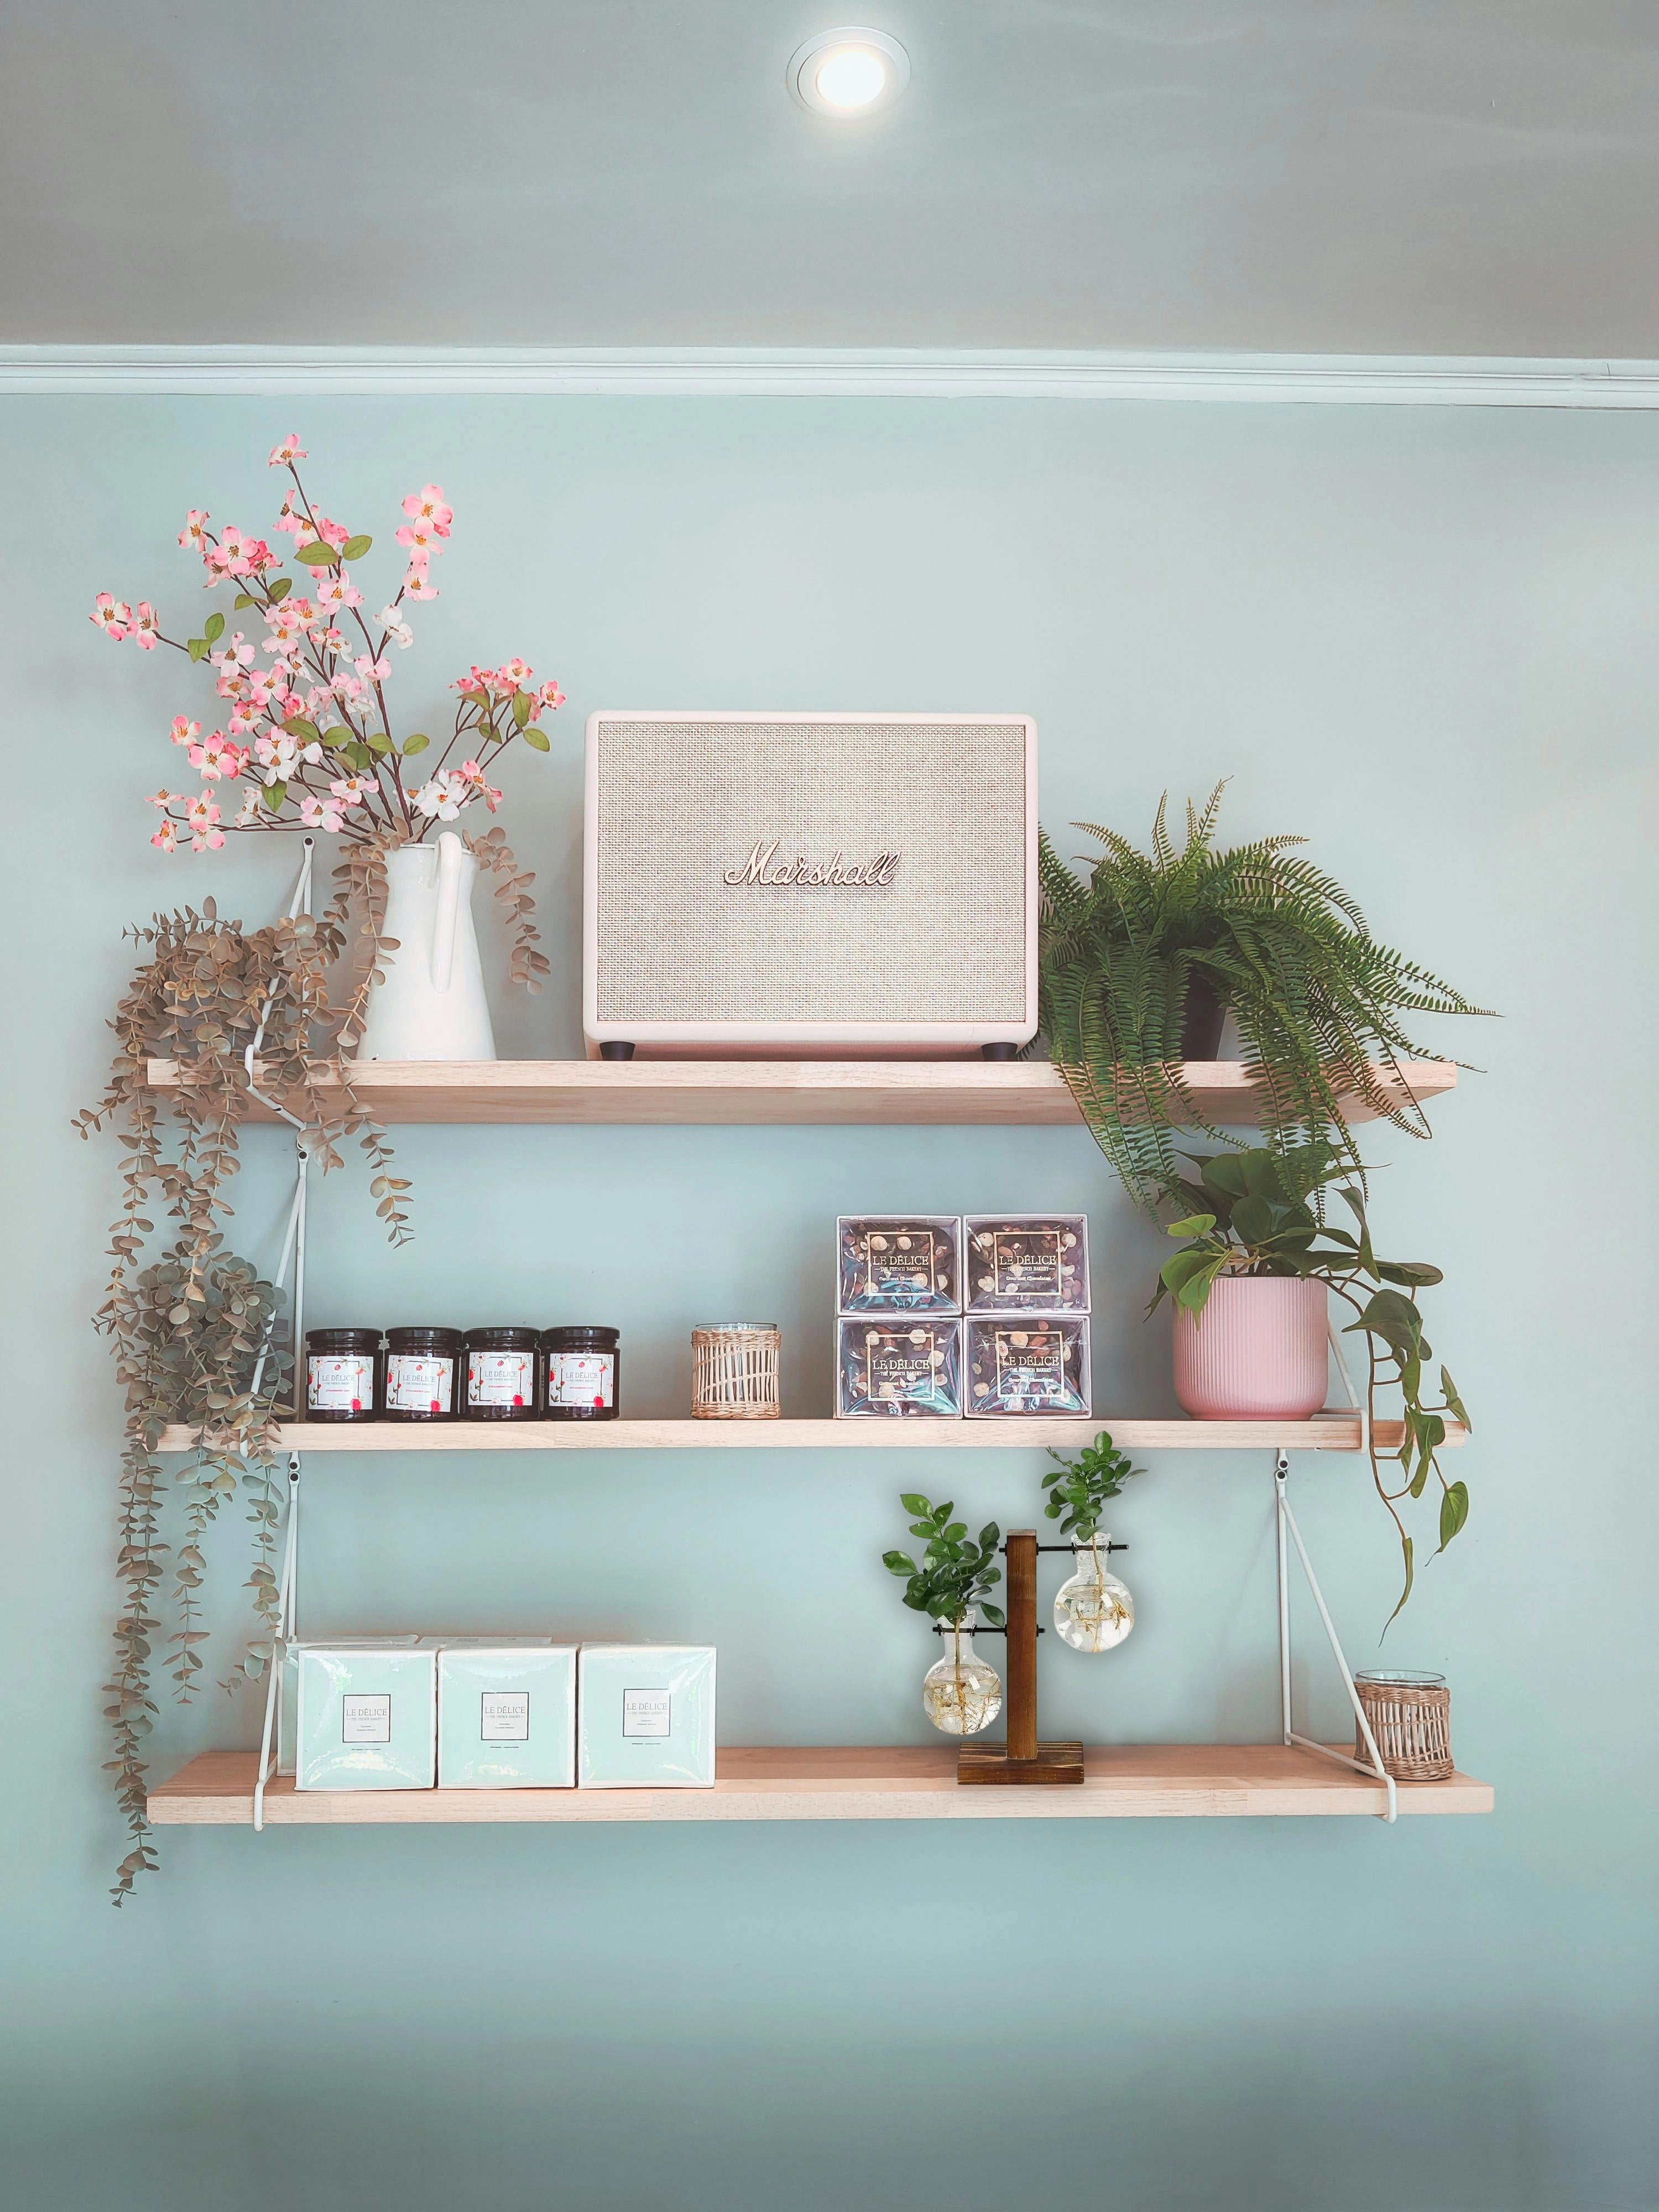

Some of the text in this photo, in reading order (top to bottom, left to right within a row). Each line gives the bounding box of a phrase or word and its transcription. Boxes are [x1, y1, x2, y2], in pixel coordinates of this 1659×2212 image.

[723, 839, 902, 886] Marshall
[873, 1254, 929, 1265] LE DÉLICE
[999, 1254, 1057, 1265] LE DÉLICE
[872, 1358, 930, 1370] LE DÉLICE
[1001, 1355, 1059, 1366] LE DÉLICE
[639, 1702, 667, 1710] DÉLICE
